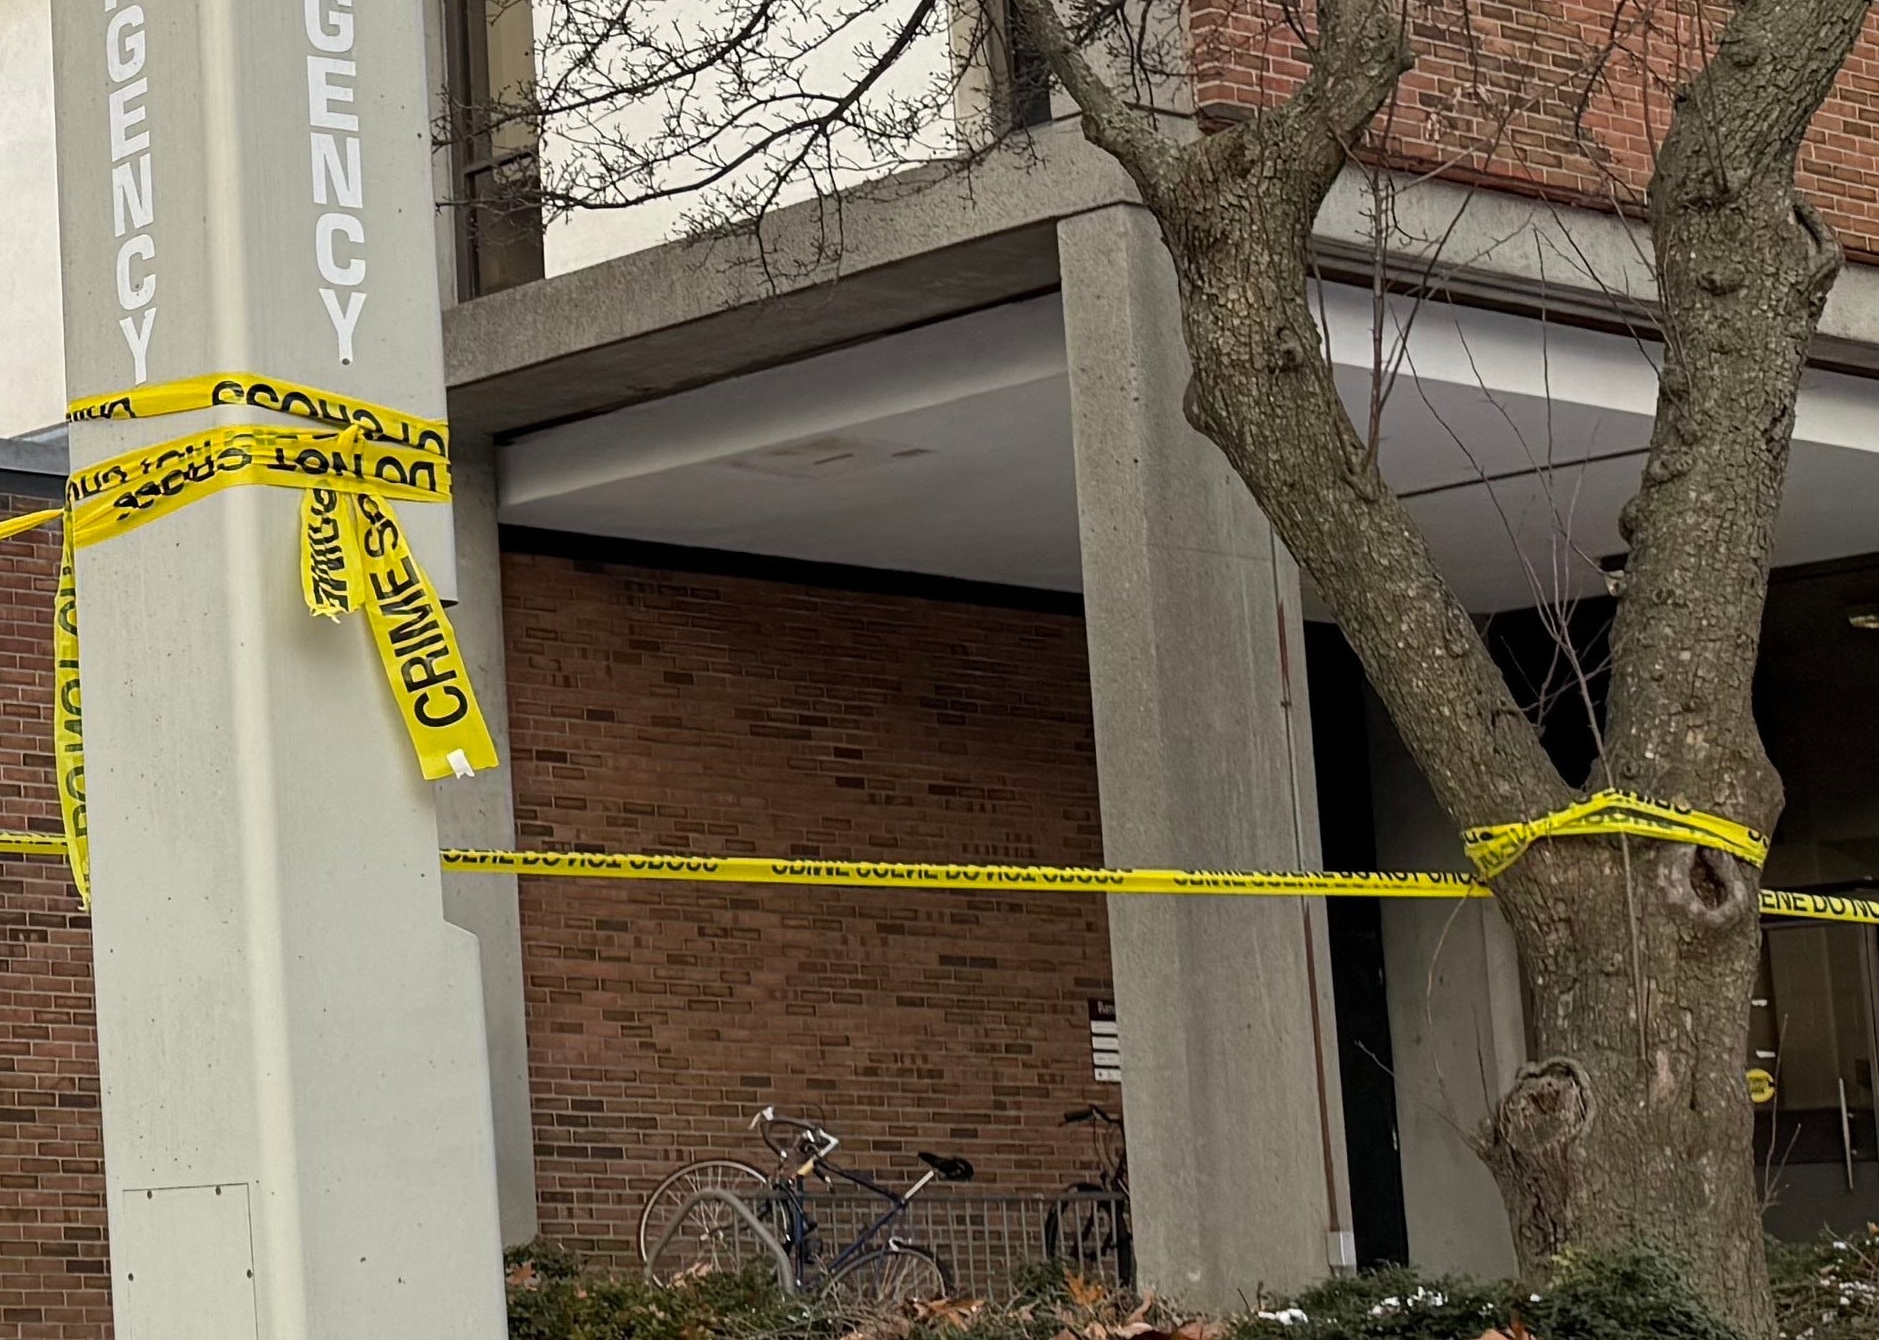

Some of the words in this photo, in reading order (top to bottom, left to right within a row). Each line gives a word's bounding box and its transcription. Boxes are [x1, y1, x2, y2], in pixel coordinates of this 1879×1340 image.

[263, 447, 364, 482] NOT
[374, 456, 437, 492] DO
[370, 556, 469, 729] CRIME
[1761, 891, 1808, 912] ENE
